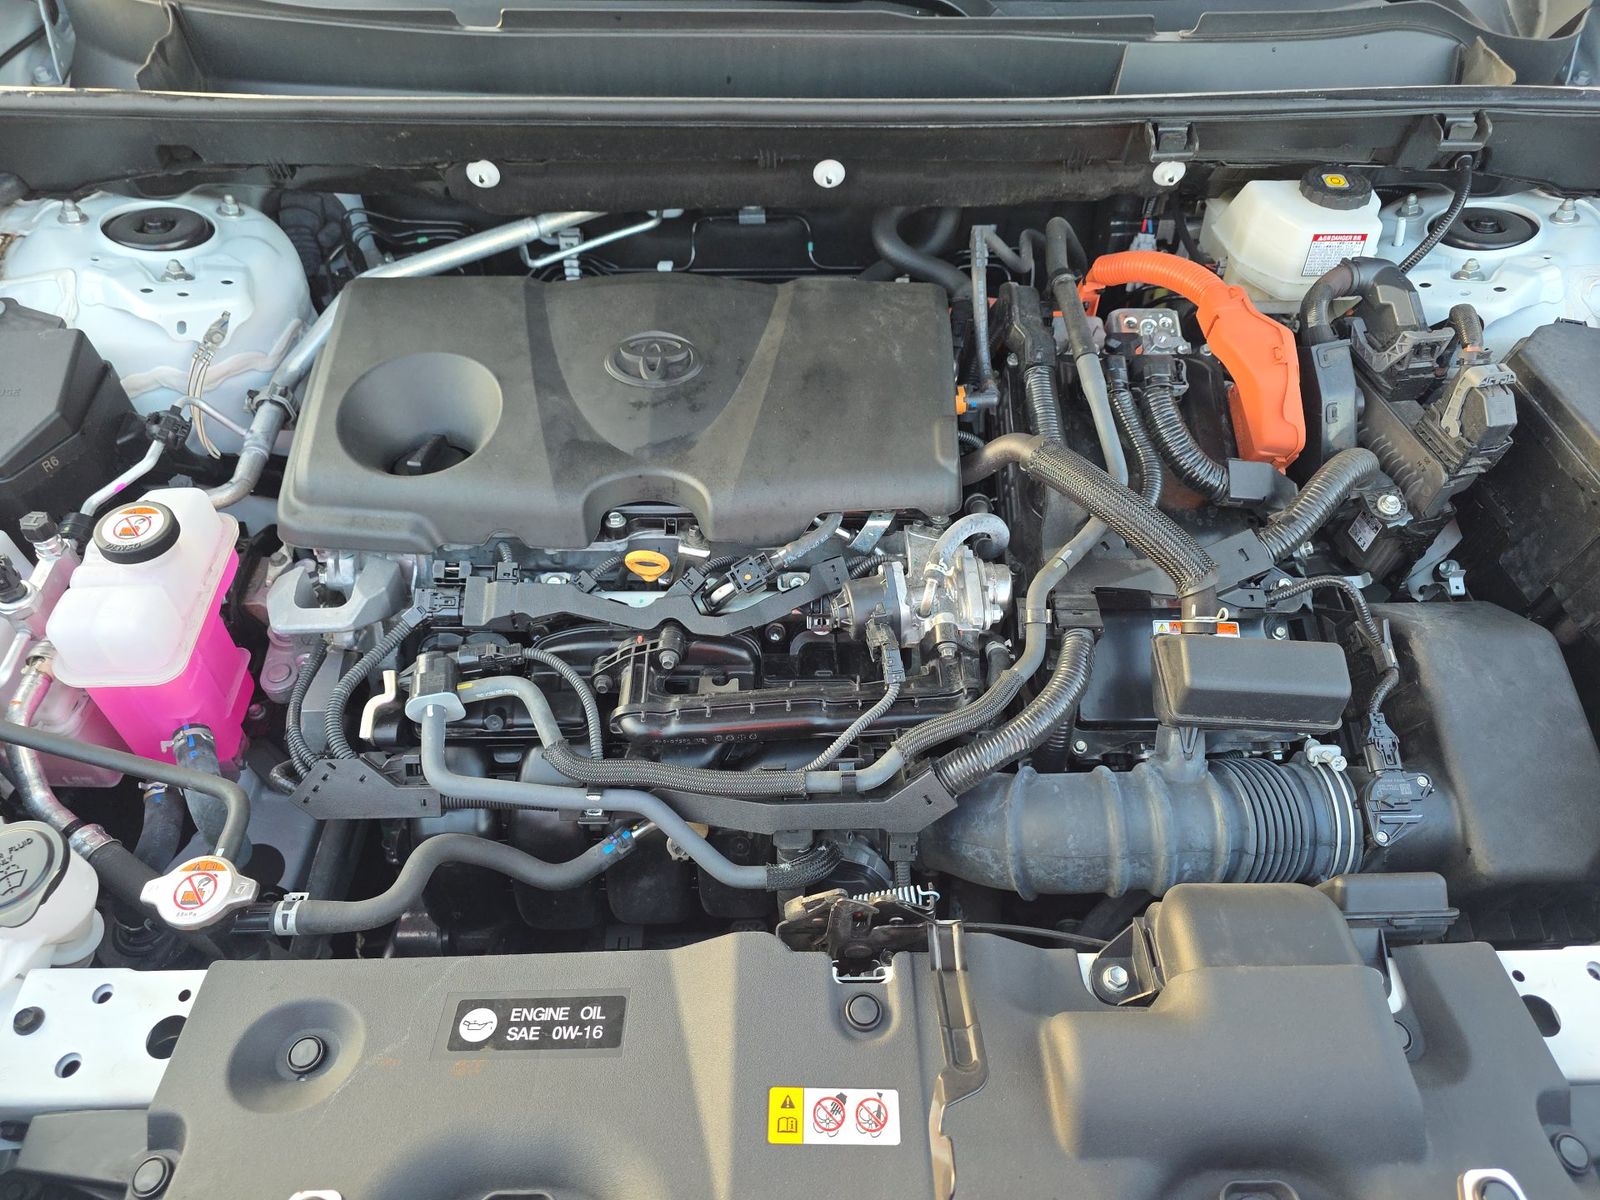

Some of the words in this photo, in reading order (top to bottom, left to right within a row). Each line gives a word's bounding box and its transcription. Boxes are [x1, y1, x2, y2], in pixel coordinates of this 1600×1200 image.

[41, 455, 60, 473] R6
[103, 542, 142, 551] DENSO
[8, 837, 33, 854] FLUID
[509, 1007, 571, 1022] ENGINE
[580, 1006, 606, 1020] OIL
[506, 1026, 541, 1041] SAE
[552, 1025, 604, 1040] 0W-16
